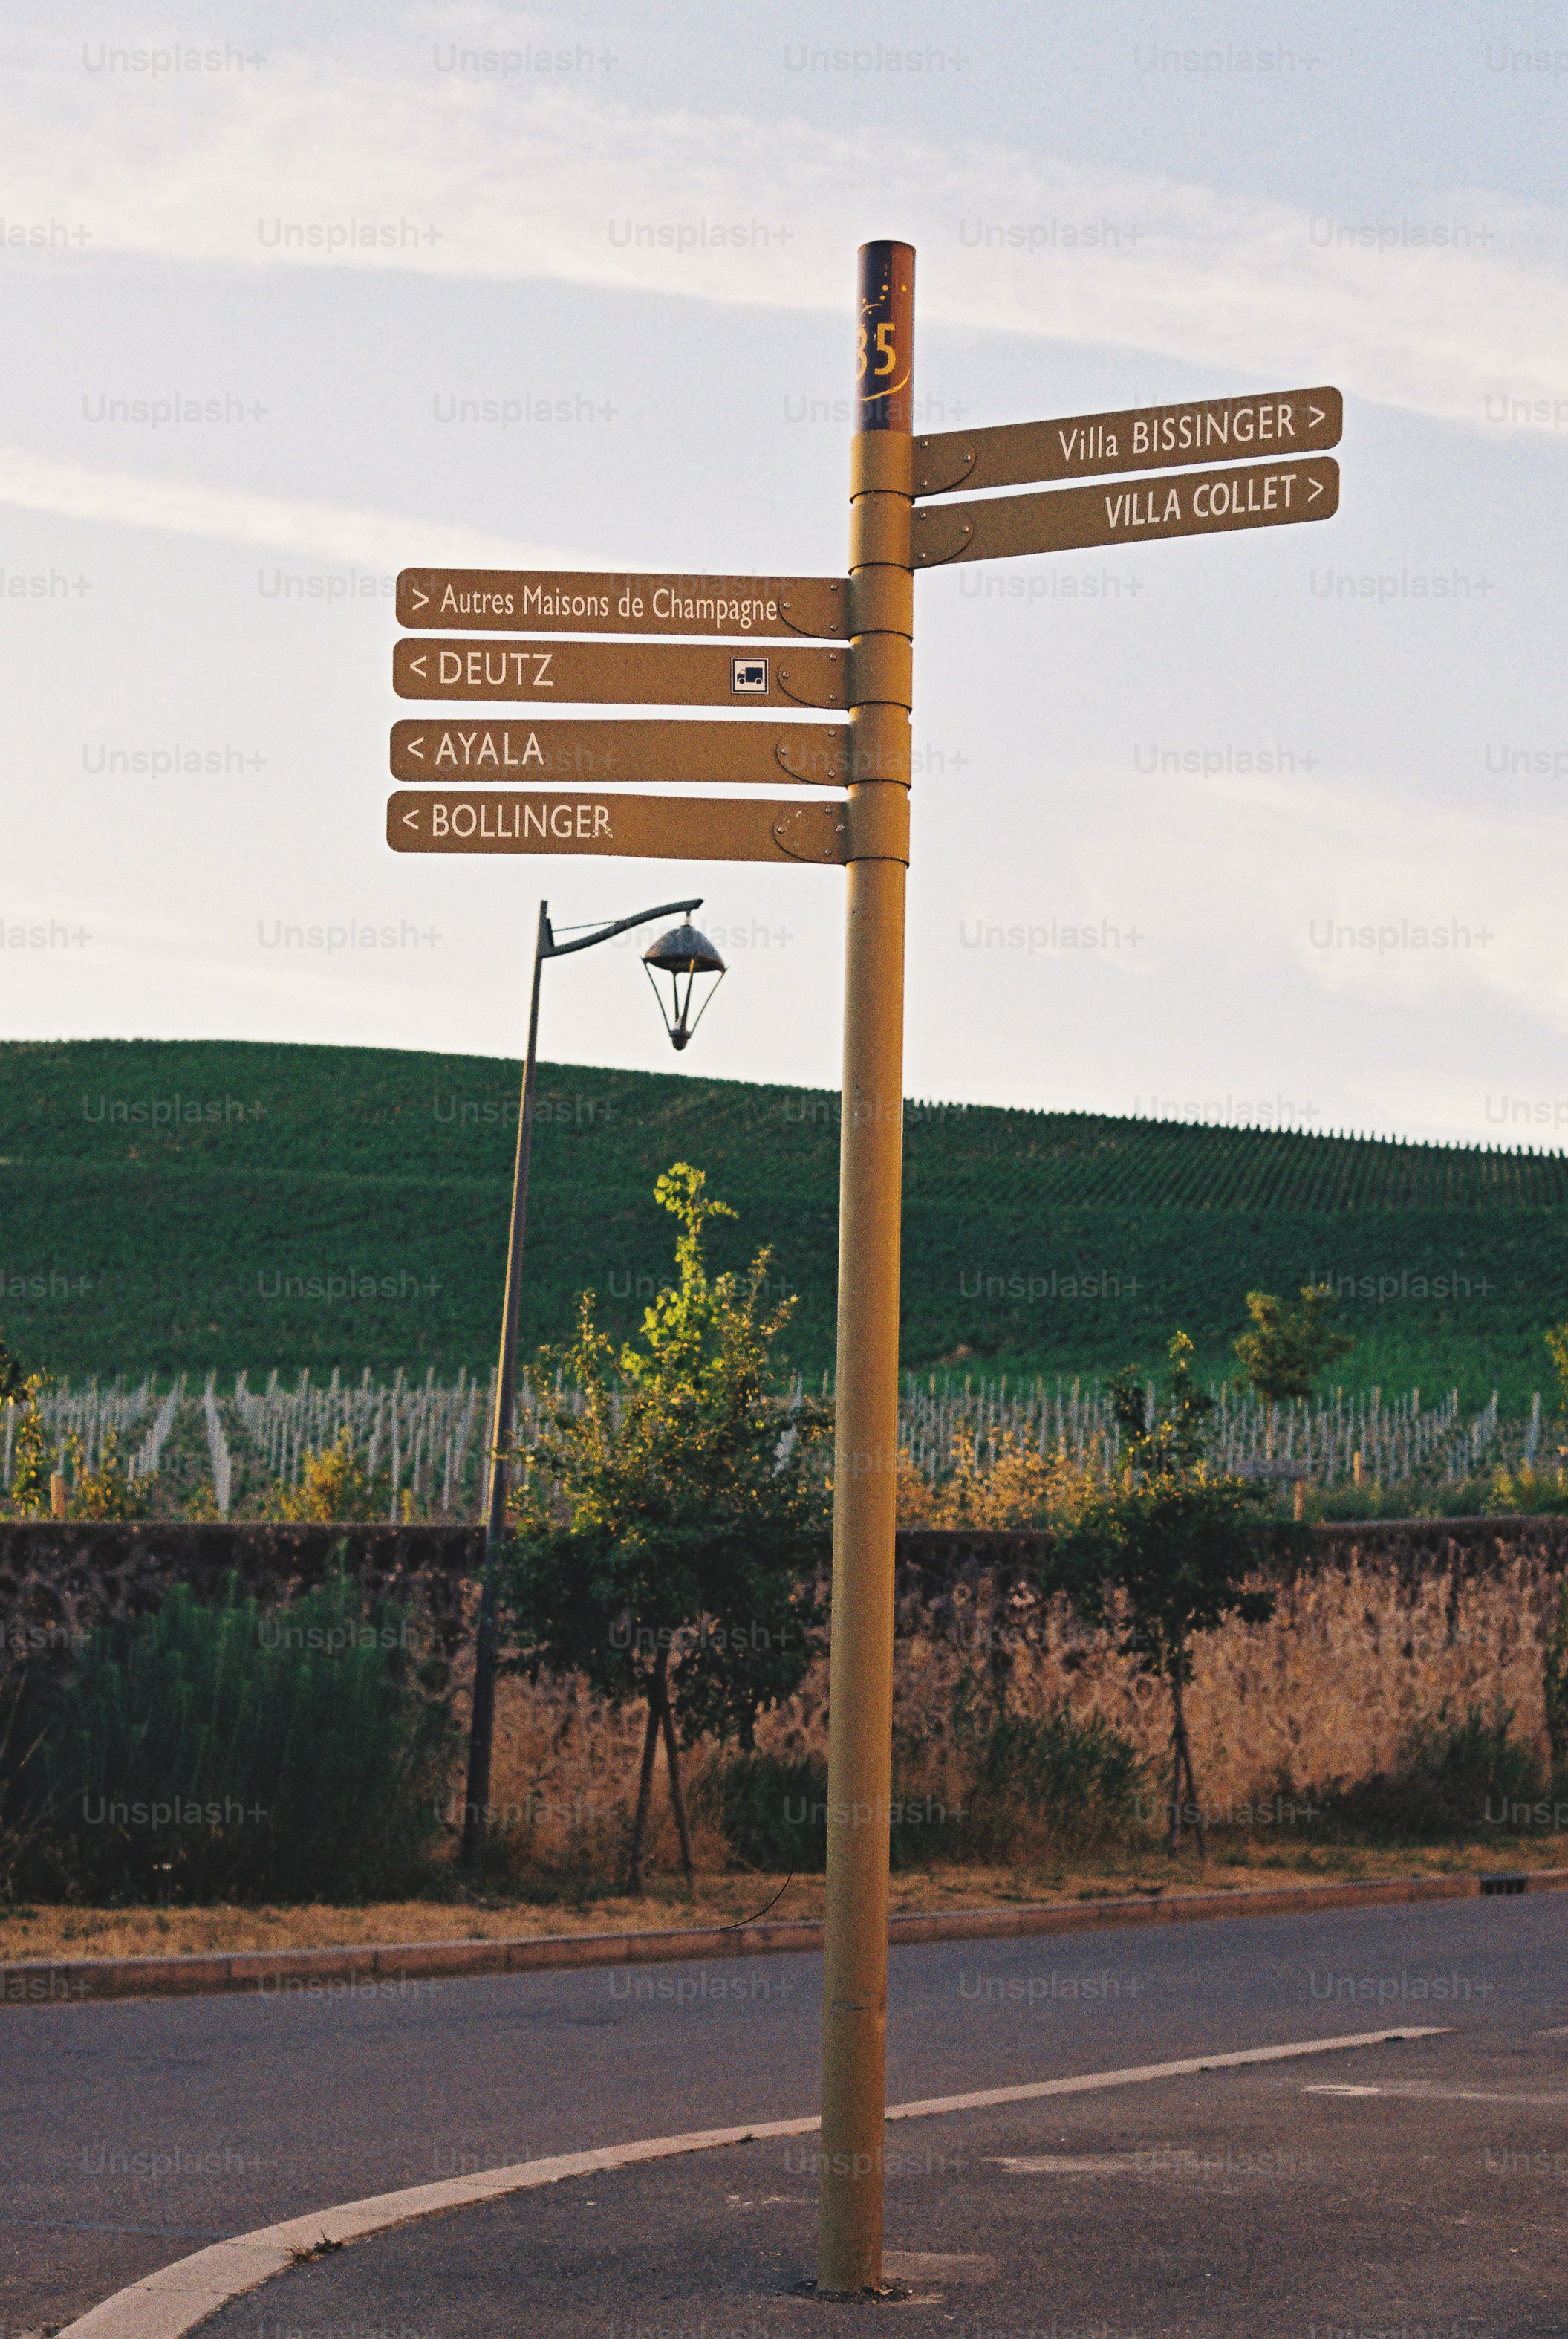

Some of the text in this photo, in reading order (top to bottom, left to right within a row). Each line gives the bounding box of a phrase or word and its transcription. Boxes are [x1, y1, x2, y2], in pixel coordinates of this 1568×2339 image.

[1058, 404, 1296, 462] Villa BISSINGER
[1105, 473, 1297, 528] VILLA COLLET
[440, 583, 778, 629] Autres Maisons de Champagne
[440, 651, 553, 686] DEUTZ
[435, 731, 544, 765] AYALA
[432, 804, 614, 839] BOLLINGER
